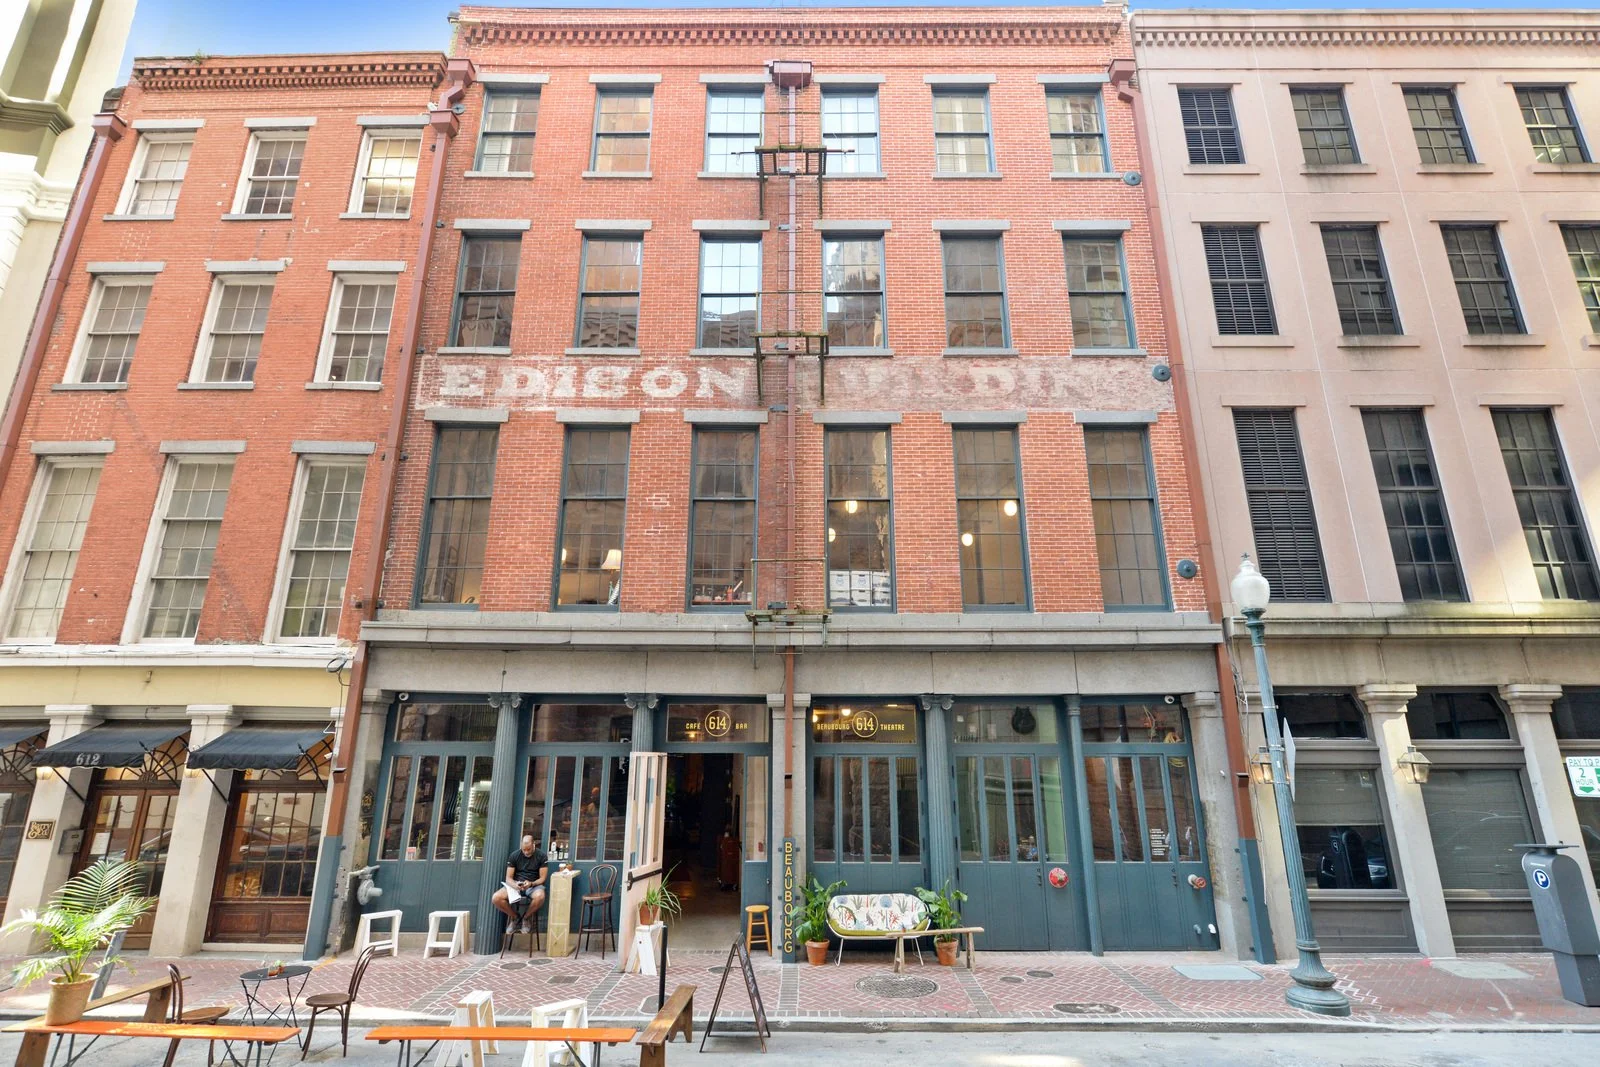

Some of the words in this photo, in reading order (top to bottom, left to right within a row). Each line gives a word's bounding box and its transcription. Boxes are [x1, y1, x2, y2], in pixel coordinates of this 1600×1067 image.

[438, 364, 751, 398] EDISON
[708, 716, 727, 730] 614
[816, 723, 850, 731] BEAUBOURG
[856, 717, 875, 731] 614
[880, 723, 905, 731] THEATRE
[76, 752, 100, 766] 612
[1568, 758, 1582, 767] PAY
[1578, 767, 1586, 778] 2
[1575, 778, 1595, 786] HOUR
[1536, 871, 1547, 886] P
[784, 842, 793, 953] BEAUBOURG
